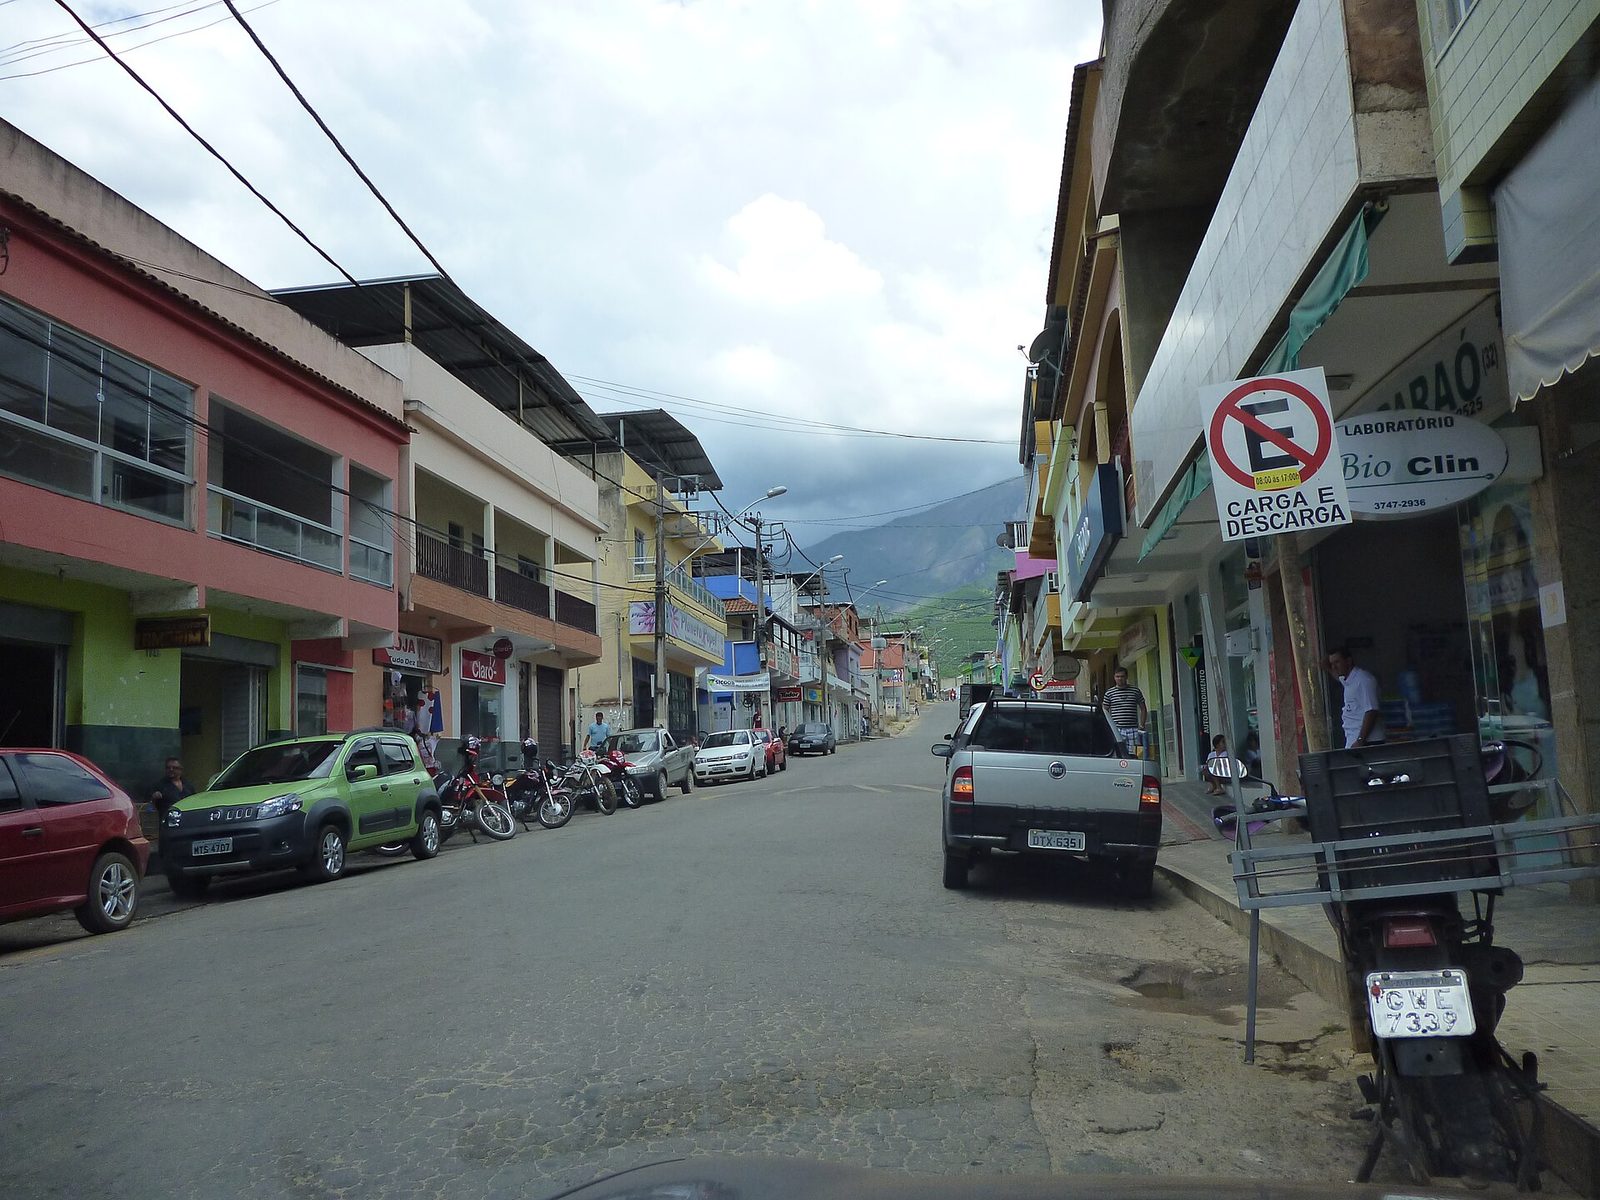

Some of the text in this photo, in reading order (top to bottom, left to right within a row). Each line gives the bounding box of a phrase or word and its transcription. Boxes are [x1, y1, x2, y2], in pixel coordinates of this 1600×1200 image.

[1378, 327, 1481, 411] ARAÓ
[1344, 415, 1455, 436] LABORATÓRIO
[1340, 453, 1480, 481] Bio Clin
[1255, 475, 1272, 485] 08:00
[1227, 486, 1335, 518] CARGA E
[1374, 498, 1426, 510] 3747-2936
[1226, 503, 1347, 537] DESCARGA
[392, 635, 416, 654] OJA
[472, 659, 495, 680] Claro
[1199, 669, 1210, 734] AUTOATENDIMENTO
[1386, 1010, 1458, 1033] 7339
